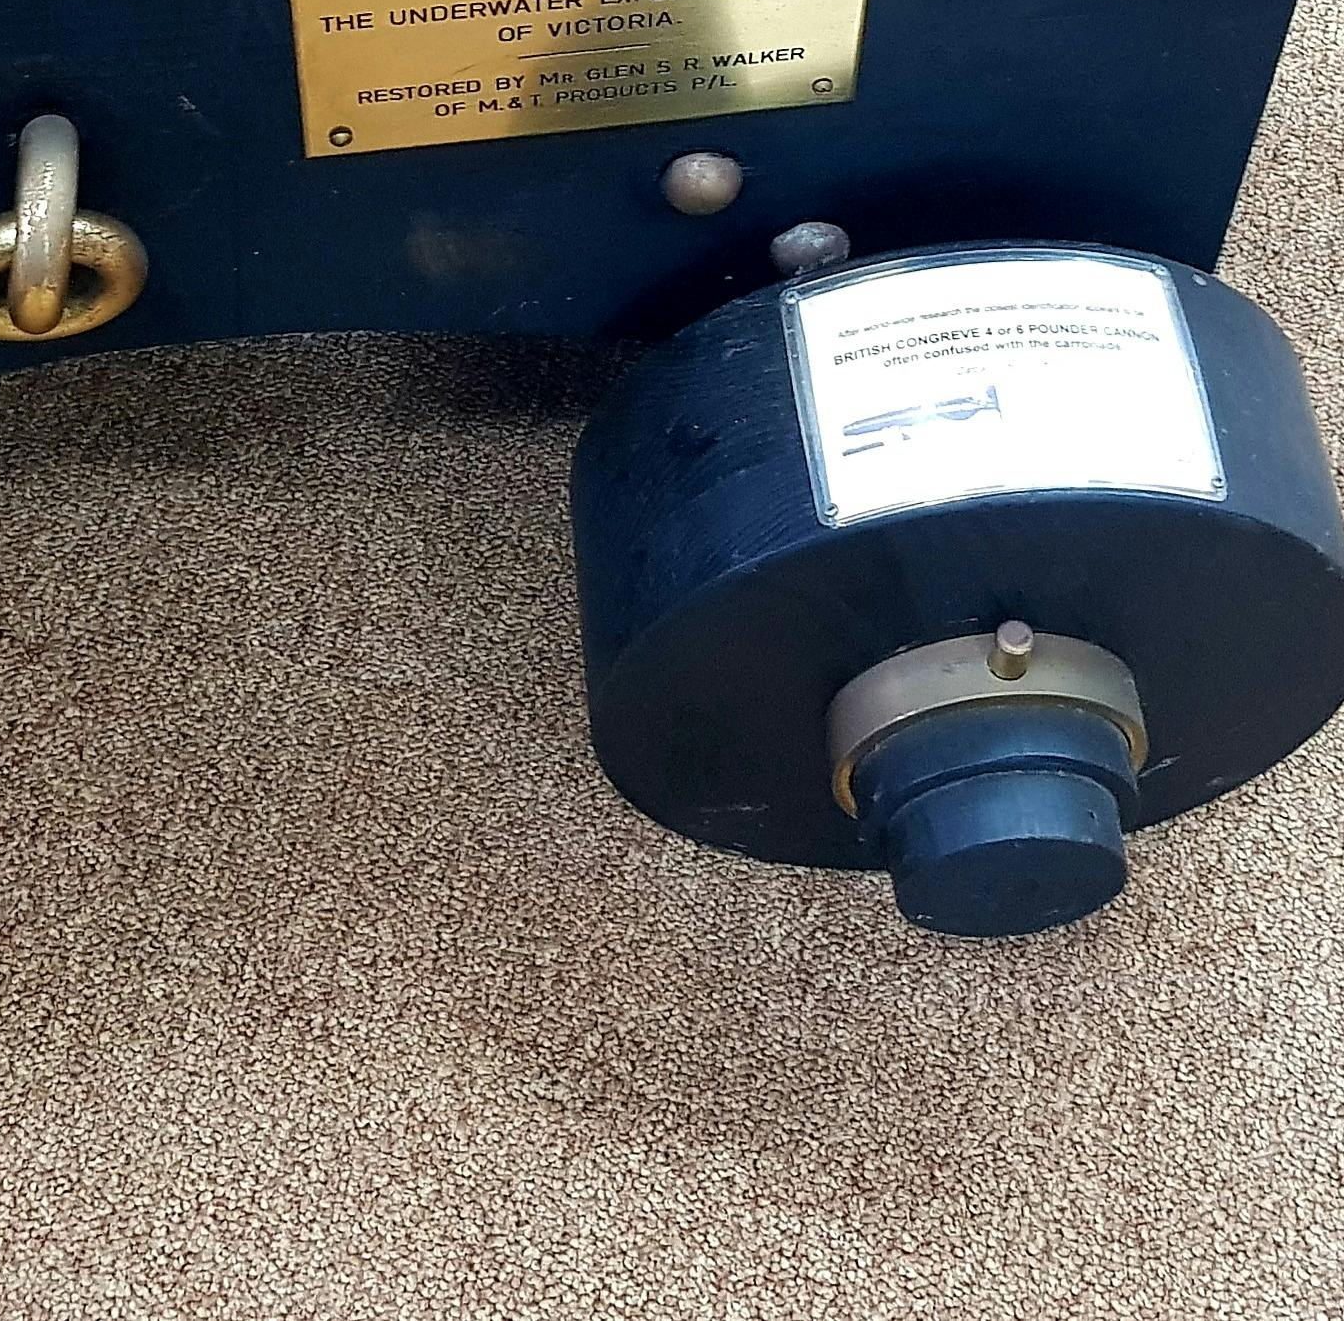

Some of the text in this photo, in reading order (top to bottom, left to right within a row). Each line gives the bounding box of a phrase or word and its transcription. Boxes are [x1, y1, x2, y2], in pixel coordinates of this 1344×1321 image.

[320, 12, 374, 33] THE
[498, 25, 532, 42] OF
[358, 80, 482, 104] RESTORED
[495, 75, 525, 91] BY
[586, 63, 645, 81] GLEN
[712, 47, 805, 67] WALKER
[435, 102, 466, 117] OF
[555, 80, 677, 105] PRODUCTS
[833, 324, 1160, 366] BRITISH CONGREVE 4 or 6 POUNDER CANNON
[883, 353, 919, 368] often
[923, 342, 990, 360] confused
[995, 340, 1024, 351] with
[1029, 339, 1050, 349] the
